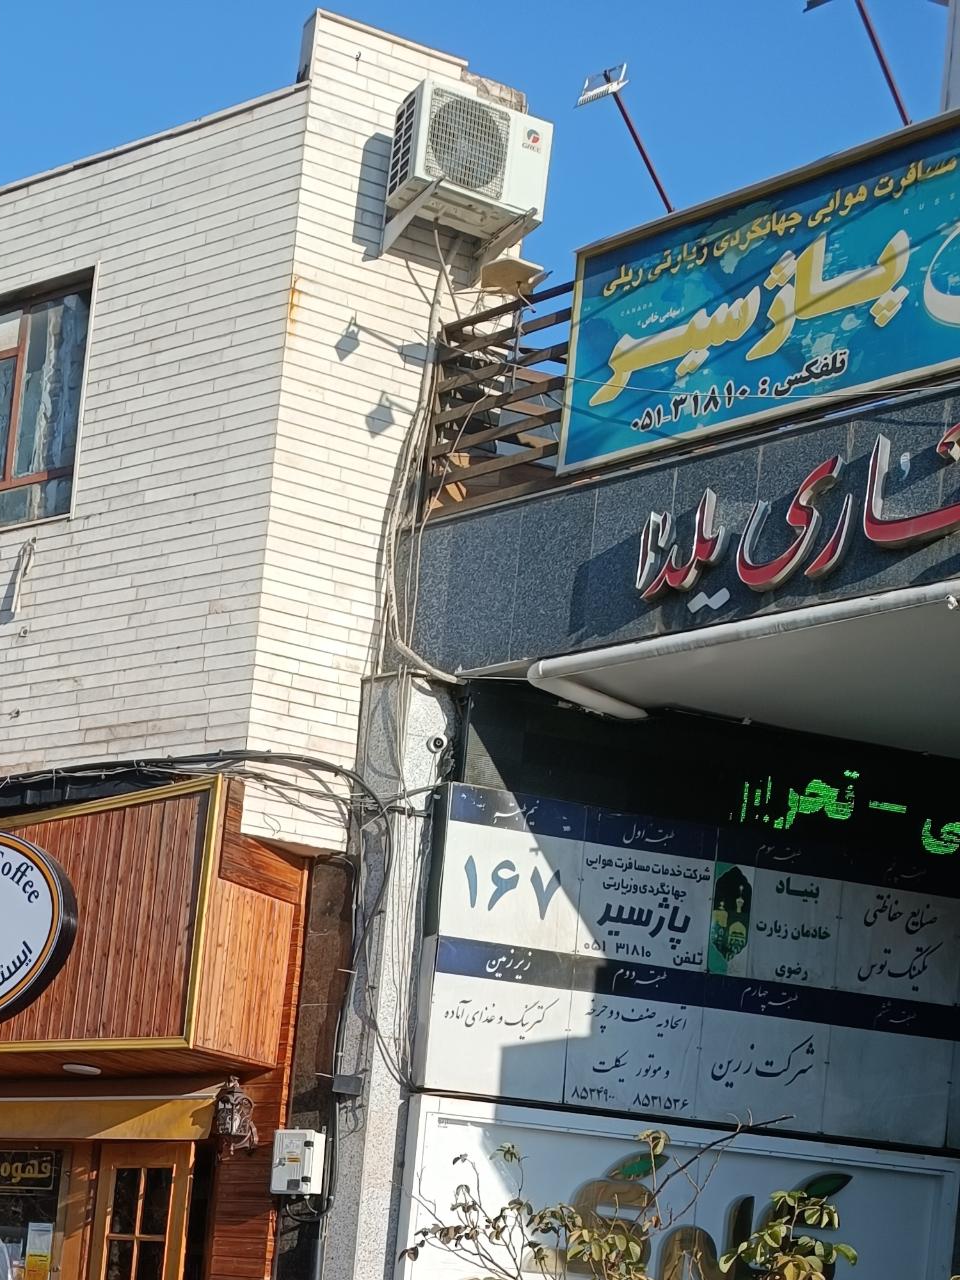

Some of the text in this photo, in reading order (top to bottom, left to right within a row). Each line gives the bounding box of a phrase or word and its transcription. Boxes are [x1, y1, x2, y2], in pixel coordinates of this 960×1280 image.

[602, 157, 958, 297] مسافرت هوایی جهانگردی زیارتی ریلی
[590, 229, 910, 407] پاژسیر
[774, 349, 850, 396] تلفکس
[622, 824, 645, 845] اول
[586, 853, 711, 882] شرکت خدمات مسافرت هوایی
[464, 855, 562, 921] ۱۶۷
[638, 880, 688, 899] جهانگردی
[775, 876, 820, 903] بنیاد
[596, 897, 691, 950] پاژسیر
[863, 894, 938, 935] صنایع حفاظتی
[756, 919, 831, 941] خادمان زیارت
[615, 942, 652, 958] ۳۱۸۱۰
[673, 948, 704, 967] تلفن
[775, 962, 808, 981] رضوی
[857, 948, 892, 982] توس
[612, 967, 637, 992] دوم
[444, 999, 473, 1021] آماده
[465, 1003, 496, 1028] غذای
[655, 1004, 688, 1039] اتحادیه
[592, 1049, 630, 1083] سیکلت
[635, 1053, 662, 1078] موتور
[711, 1034, 815, 1089] شرکت زرین
[0, 1156, 52, 1184] قهوه
